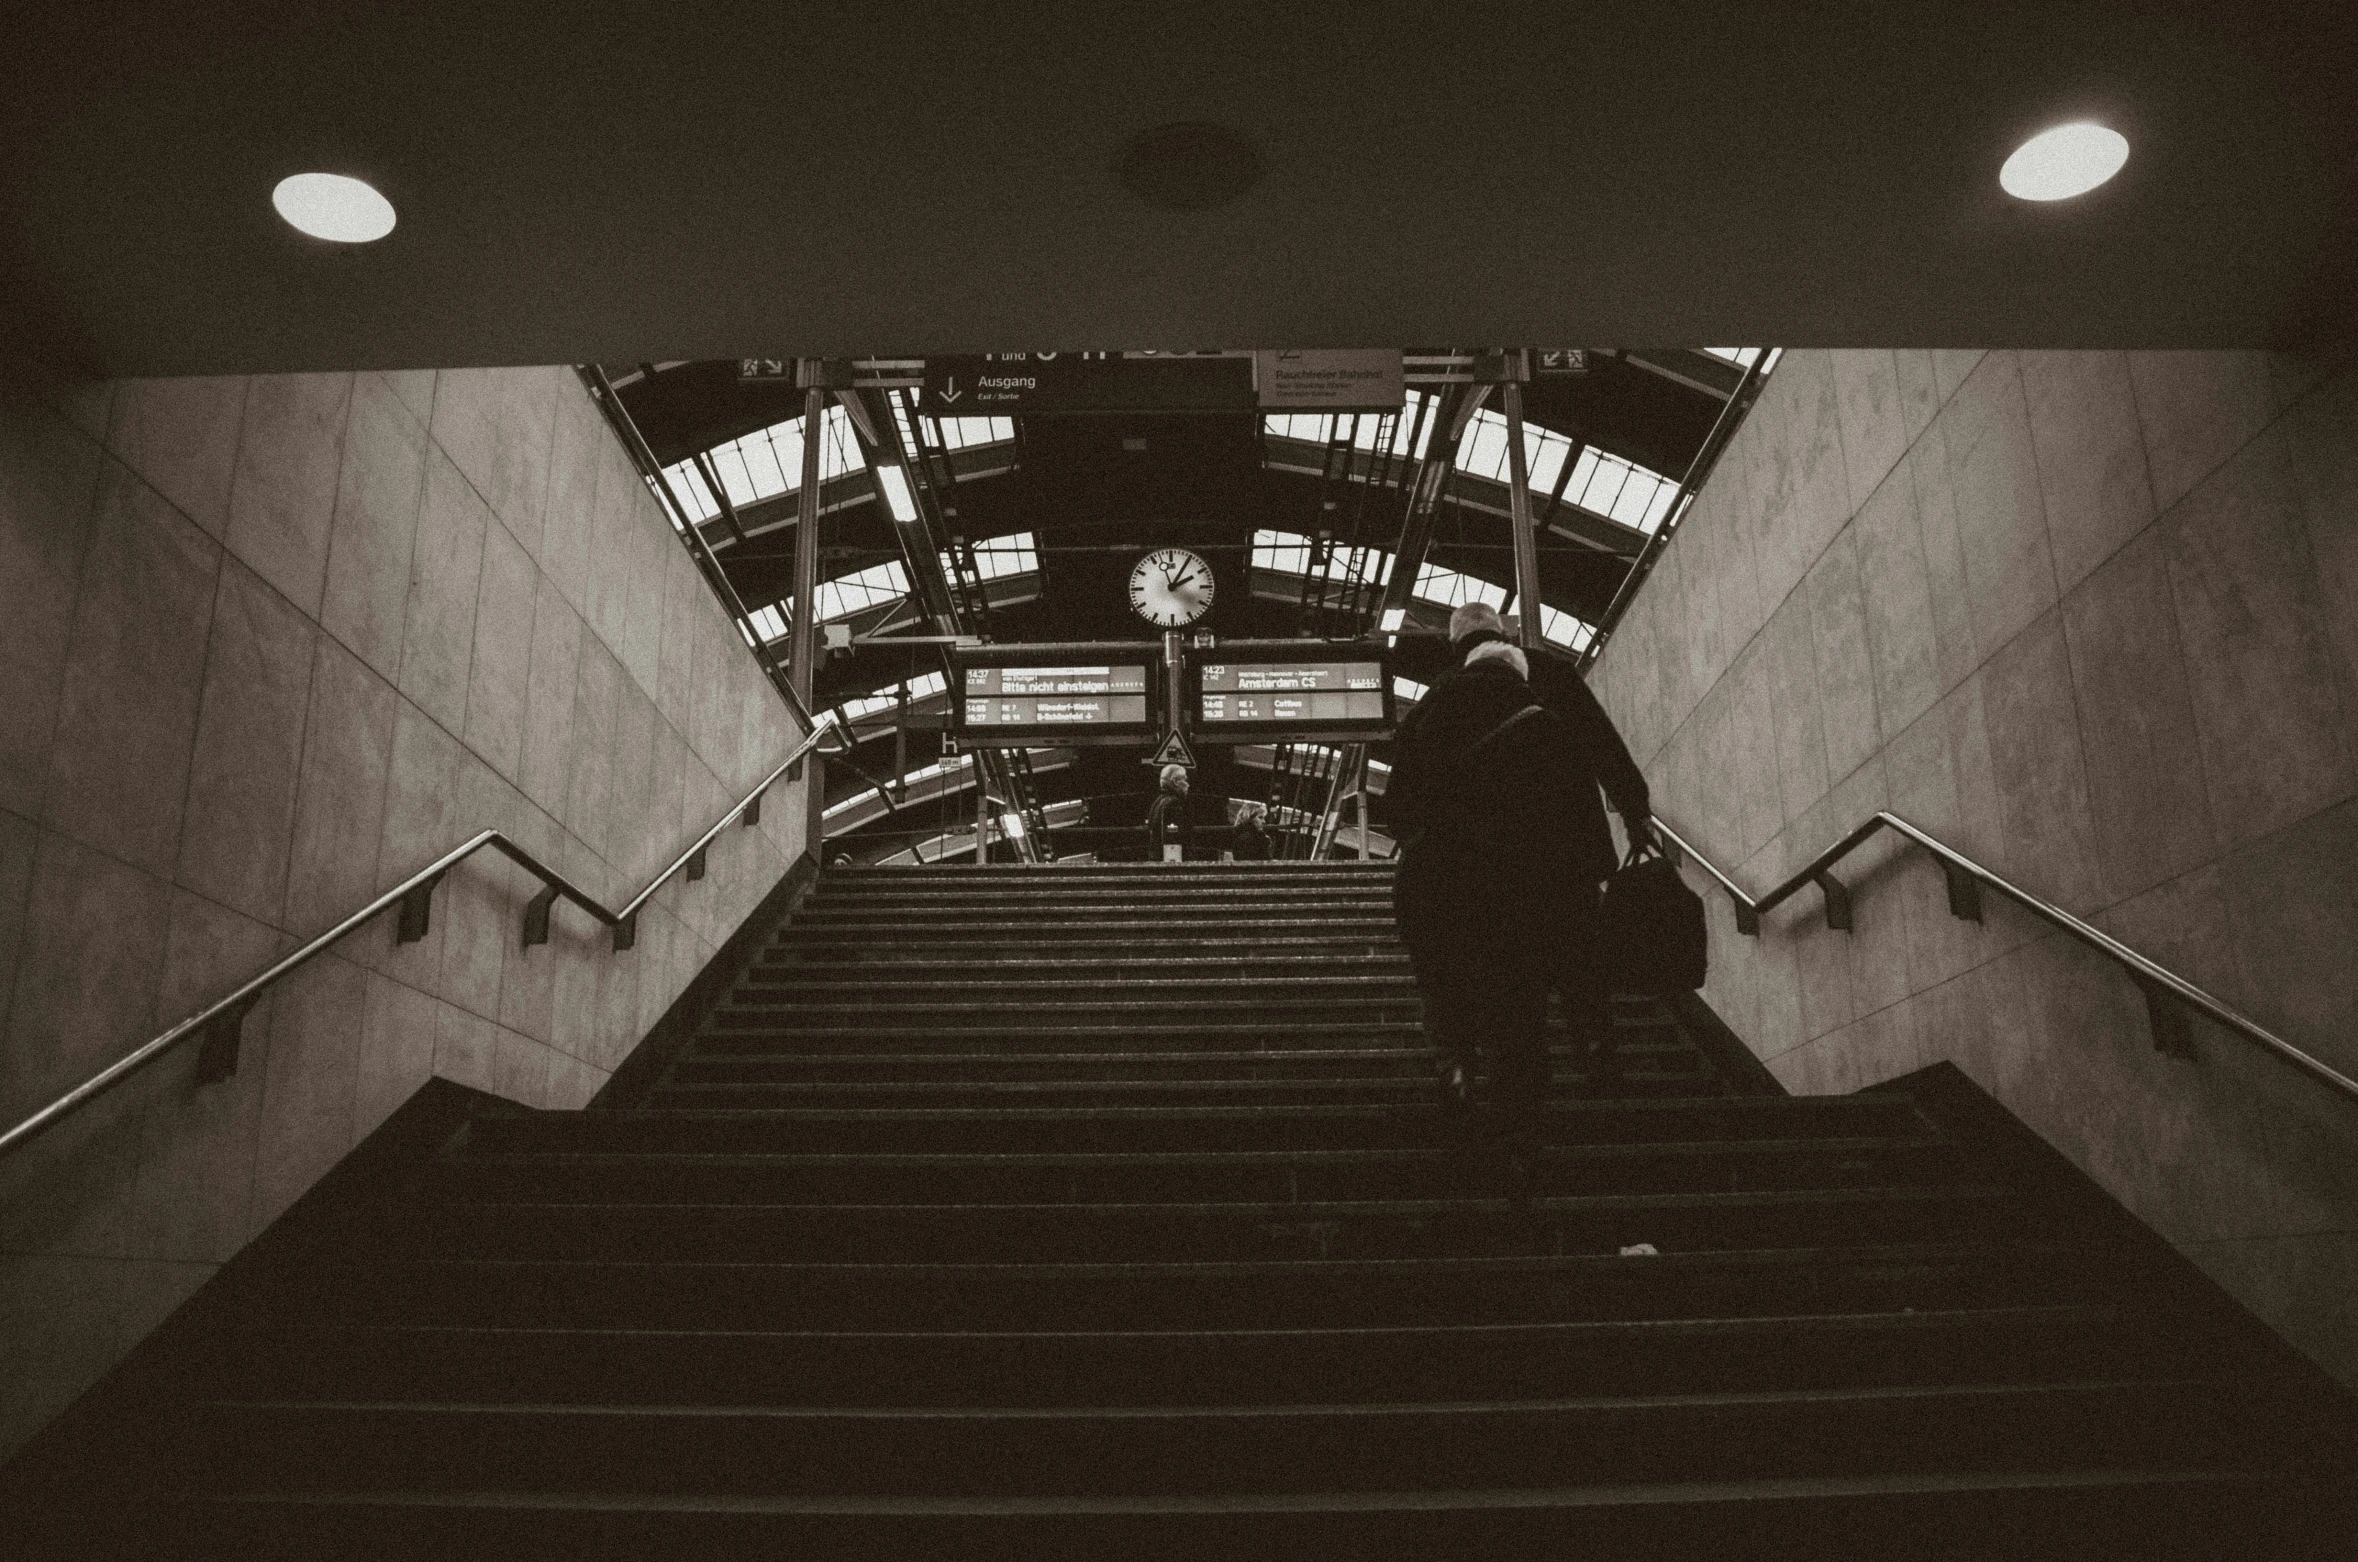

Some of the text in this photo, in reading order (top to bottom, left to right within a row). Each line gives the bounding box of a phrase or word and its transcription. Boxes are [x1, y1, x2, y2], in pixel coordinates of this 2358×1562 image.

[978, 376, 1036, 389] Ausgang
[967, 670, 989, 678] 14:37
[1203, 666, 1225, 674] 14:23
[1002, 682, 1026, 692] Bitte
[1028, 682, 1054, 692] nicht
[1057, 681, 1109, 693] einsteigen
[1238, 677, 1316, 689] Amsterdam CS
